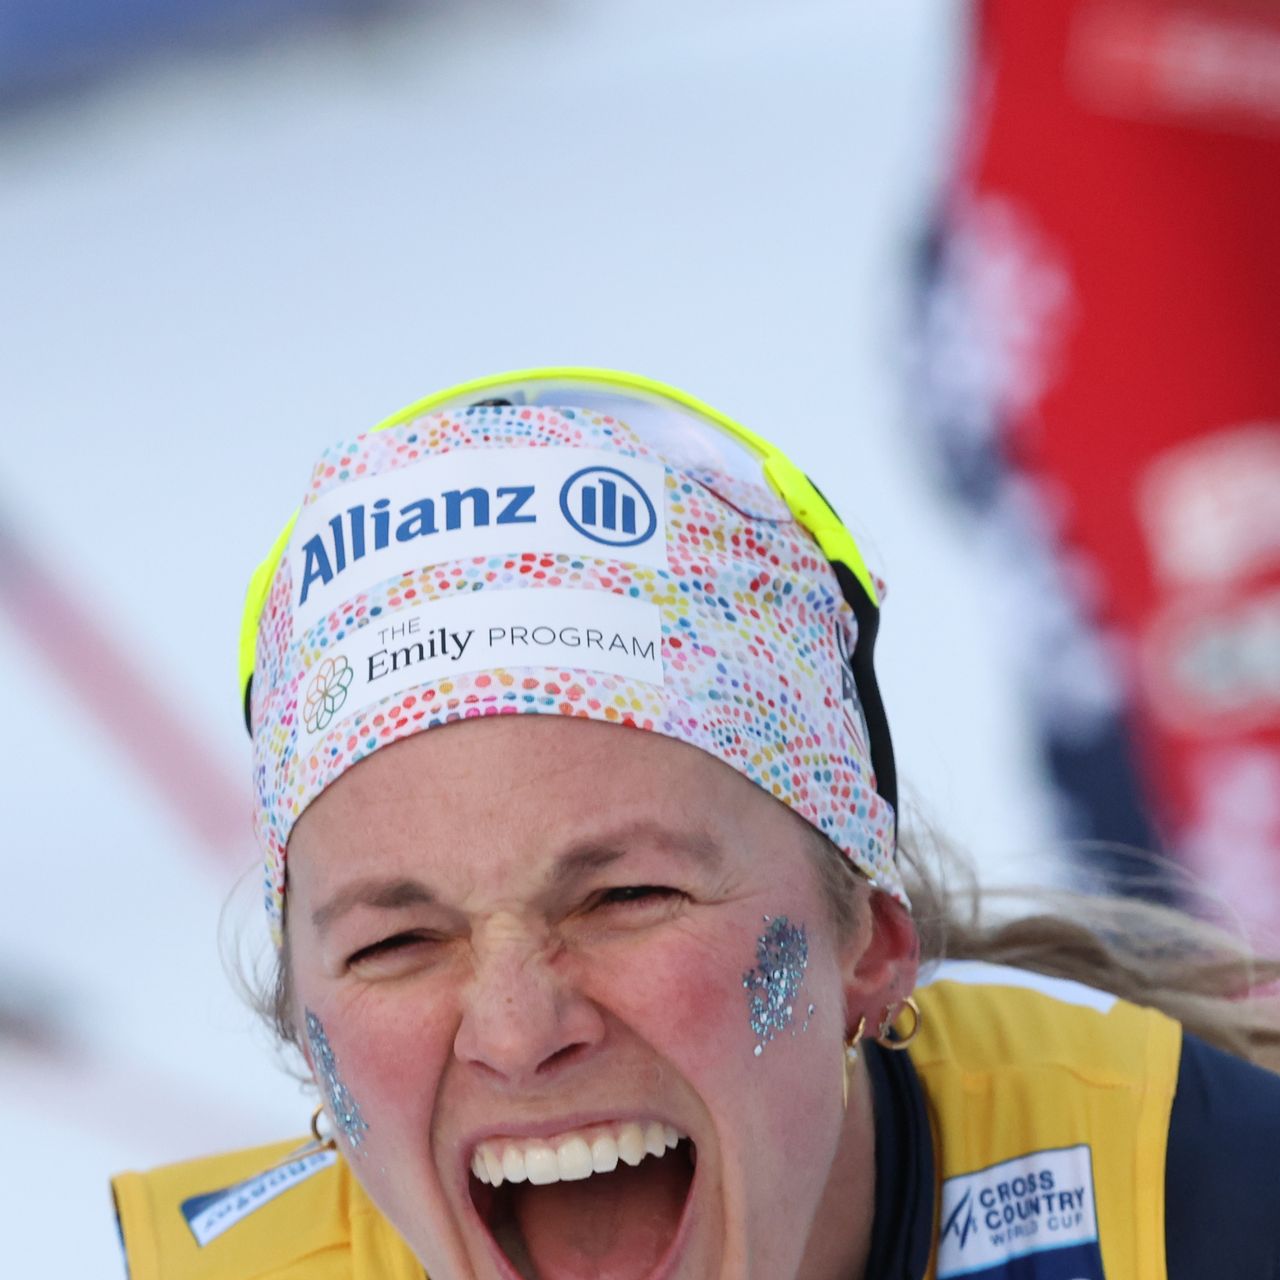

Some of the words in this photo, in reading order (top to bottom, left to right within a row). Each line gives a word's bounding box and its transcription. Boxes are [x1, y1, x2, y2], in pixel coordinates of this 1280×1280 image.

[299, 485, 536, 606] Allianz
[378, 617, 421, 646] THE
[366, 627, 475, 683] Emily
[488, 626, 656, 661] PROGRAM
[980, 1170, 1055, 1208] CROSS
[985, 1187, 1085, 1230] COUNTRY
[1047, 1213, 1083, 1231] CUP
